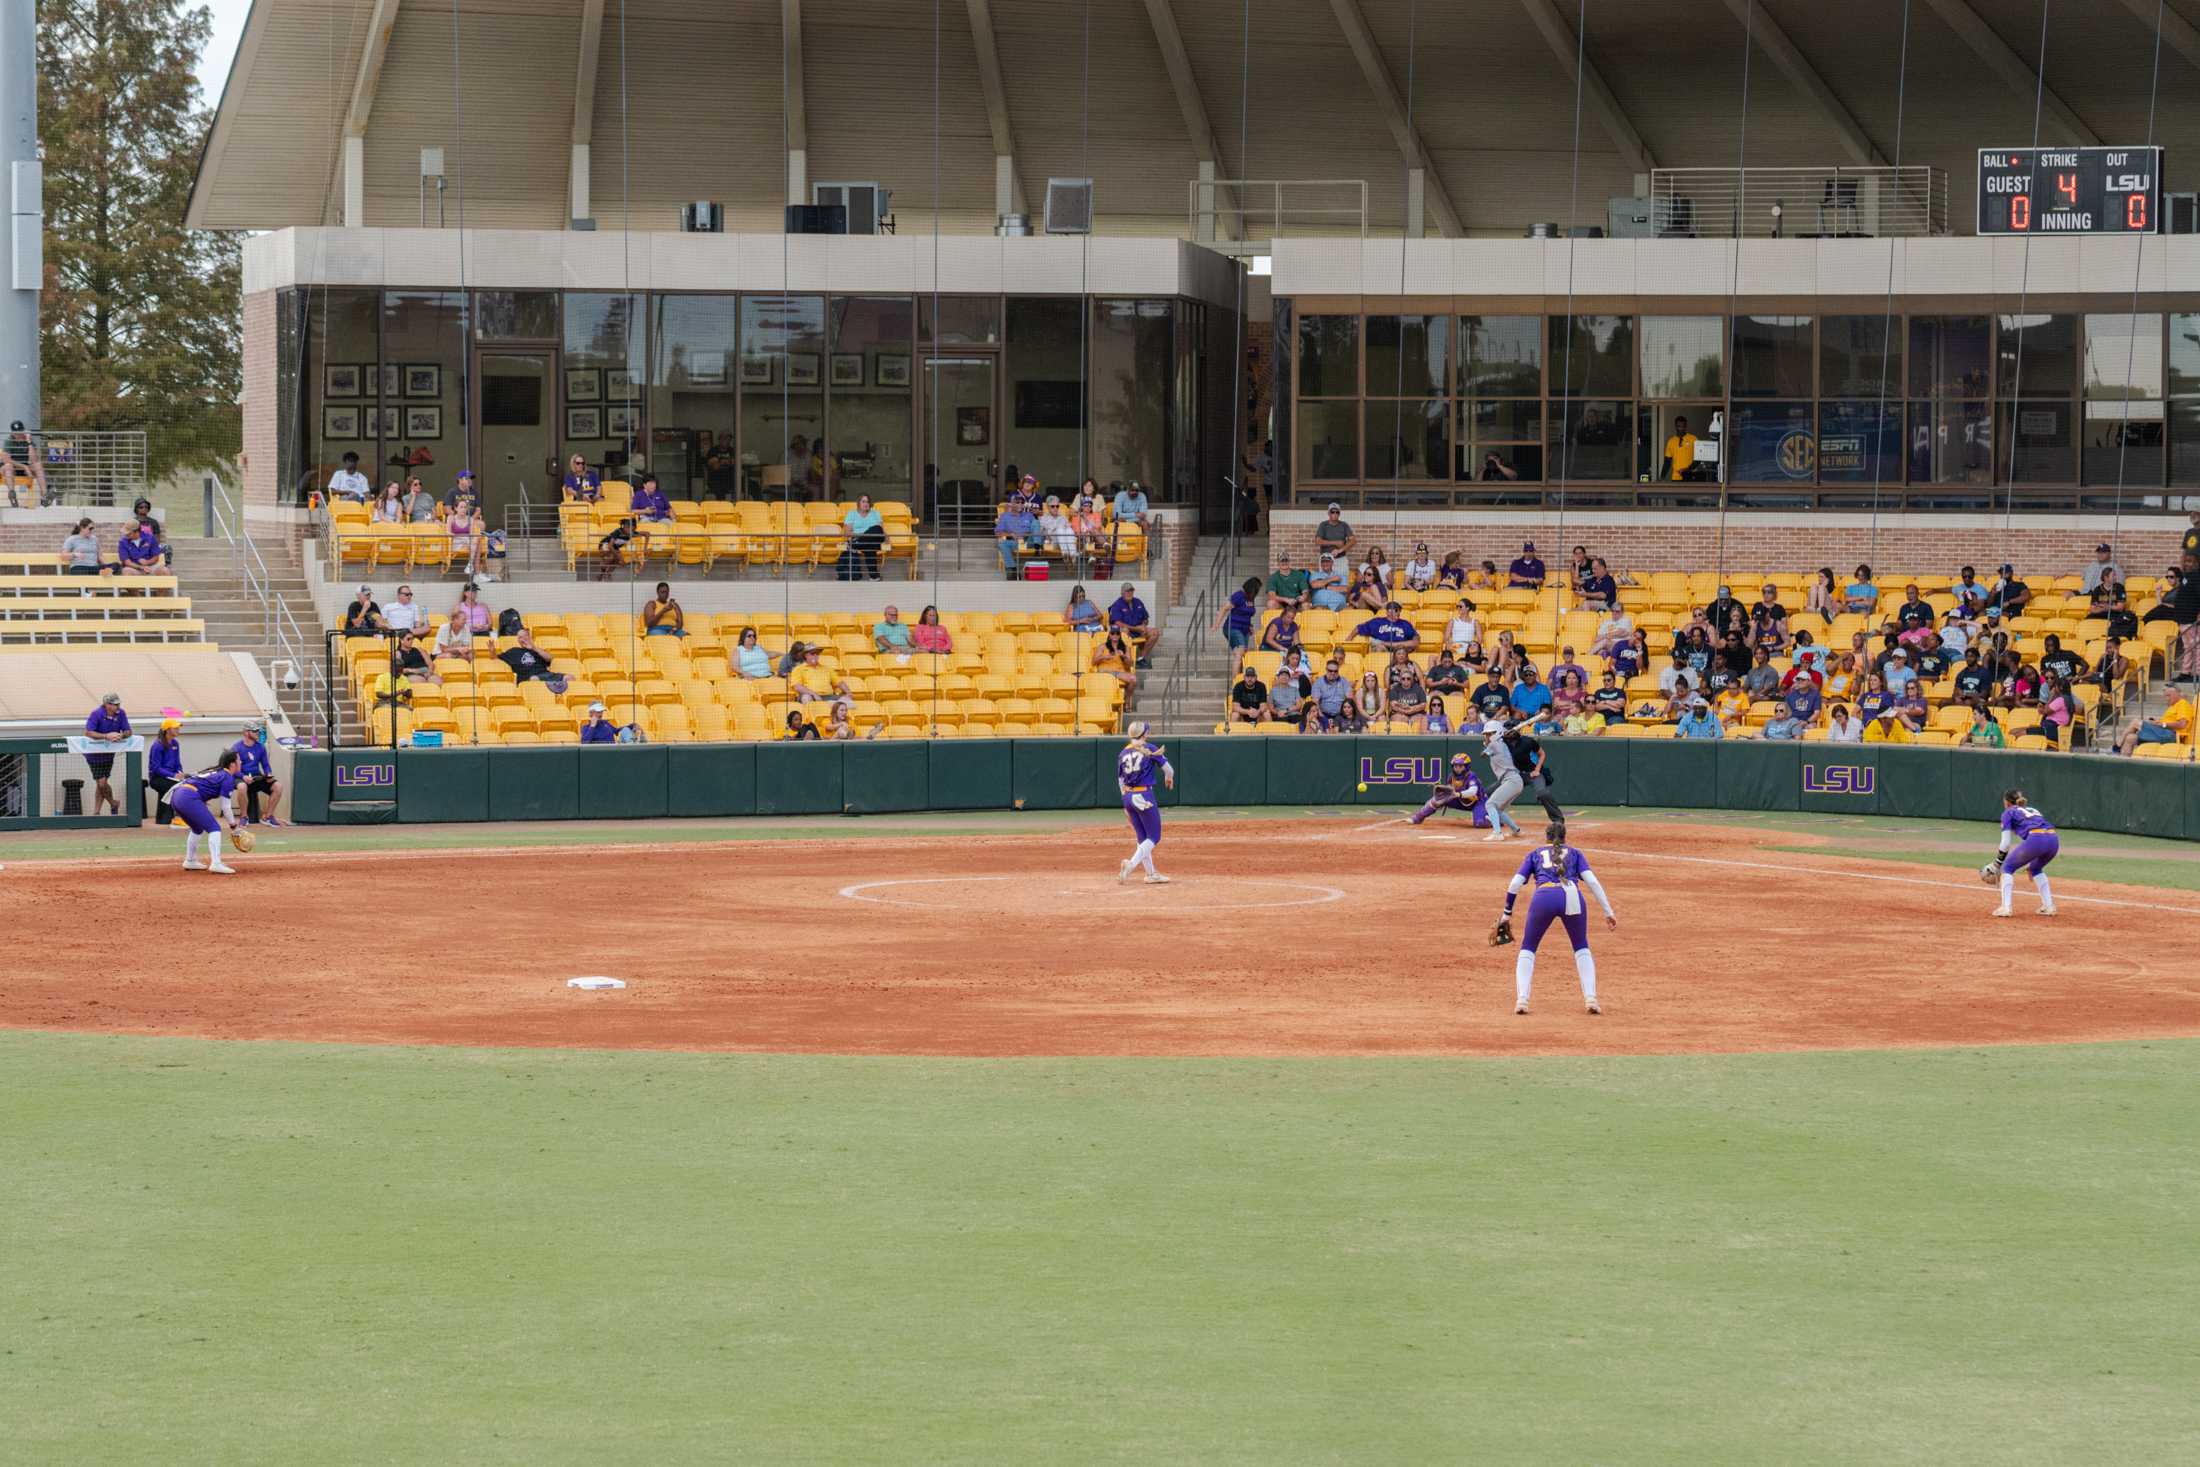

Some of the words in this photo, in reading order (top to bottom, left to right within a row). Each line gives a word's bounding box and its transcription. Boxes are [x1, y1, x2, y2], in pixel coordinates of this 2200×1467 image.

[1984, 155, 2008, 167] BALL
[2041, 154, 2078, 167] STRIKE
[2107, 153, 2128, 166] OUT
[1986, 176, 2032, 193] GUEST
[2058, 174, 2077, 204] 4
[2106, 175, 2150, 192] LSU
[2012, 196, 2030, 229] 0
[2041, 213, 2092, 229] INNING
[2128, 195, 2146, 228] 0
[1820, 439, 1860, 451] ESPN
[1122, 751, 1144, 774] 37
[1361, 757, 1442, 785] LSU
[337, 765, 395, 787] LSU
[1803, 764, 1874, 794] LSU
